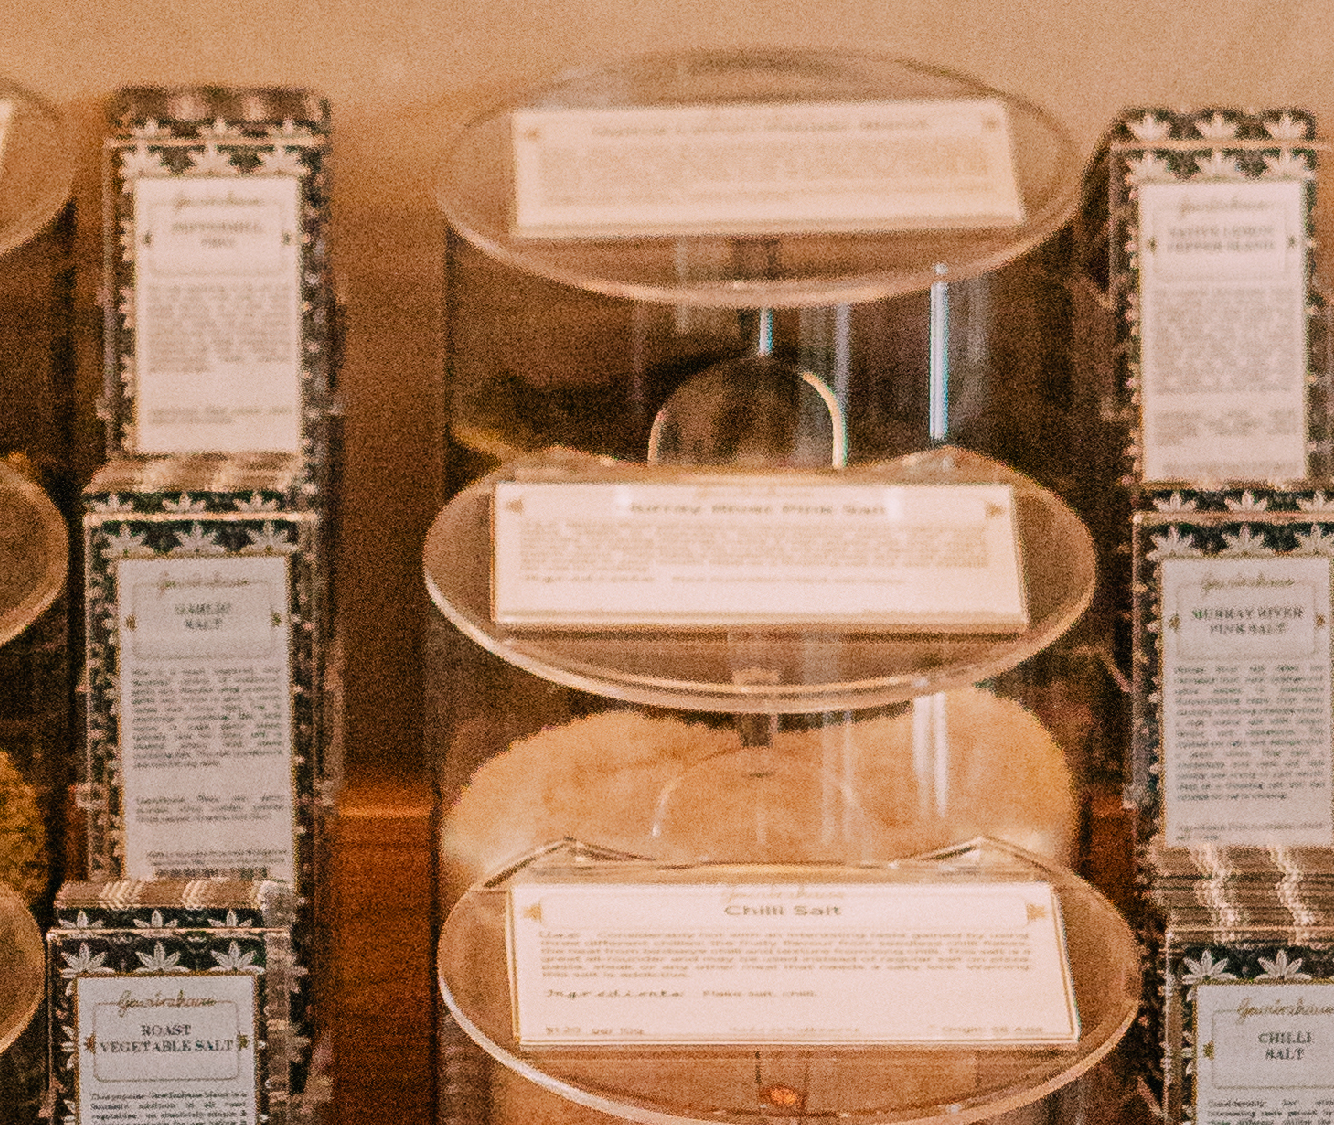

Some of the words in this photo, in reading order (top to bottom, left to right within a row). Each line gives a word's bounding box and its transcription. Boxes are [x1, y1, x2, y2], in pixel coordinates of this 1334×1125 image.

[724, 905, 784, 916] Chilli
[794, 905, 841, 916] Salt
[141, 1024, 192, 1037] ROAST
[1257, 1031, 1314, 1044] CHILLI
[99, 1039, 193, 1053] VEGETABLE
[195, 1038, 234, 1052] SALT
[1265, 1047, 1306, 1061] SALT
